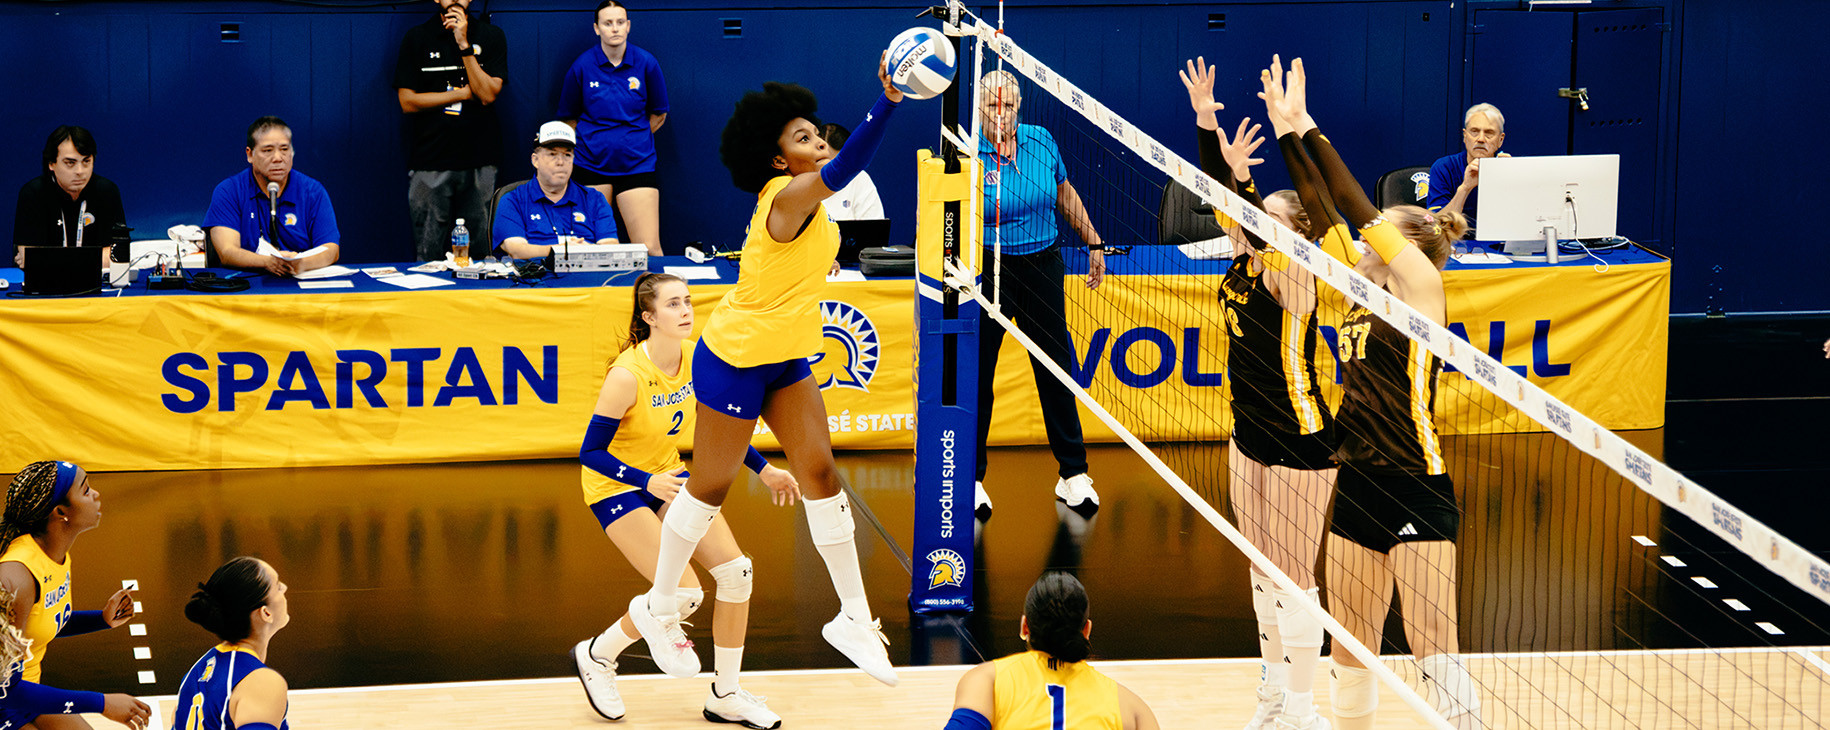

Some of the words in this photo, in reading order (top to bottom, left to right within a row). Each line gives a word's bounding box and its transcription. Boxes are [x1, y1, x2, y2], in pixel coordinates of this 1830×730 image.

[896, 45, 928, 77] molten
[944, 211, 955, 248] sports
[1067, 318, 1572, 389] VOLALL
[1338, 321, 1371, 363] 57
[160, 344, 559, 414] SPARTAN
[667, 410, 684, 436] 2
[828, 409, 851, 432] SÉ
[856, 413, 914, 432] STATE
[940, 429, 956, 478] sports
[939, 479, 955, 538] imports
[1046, 683, 1066, 730] 1
